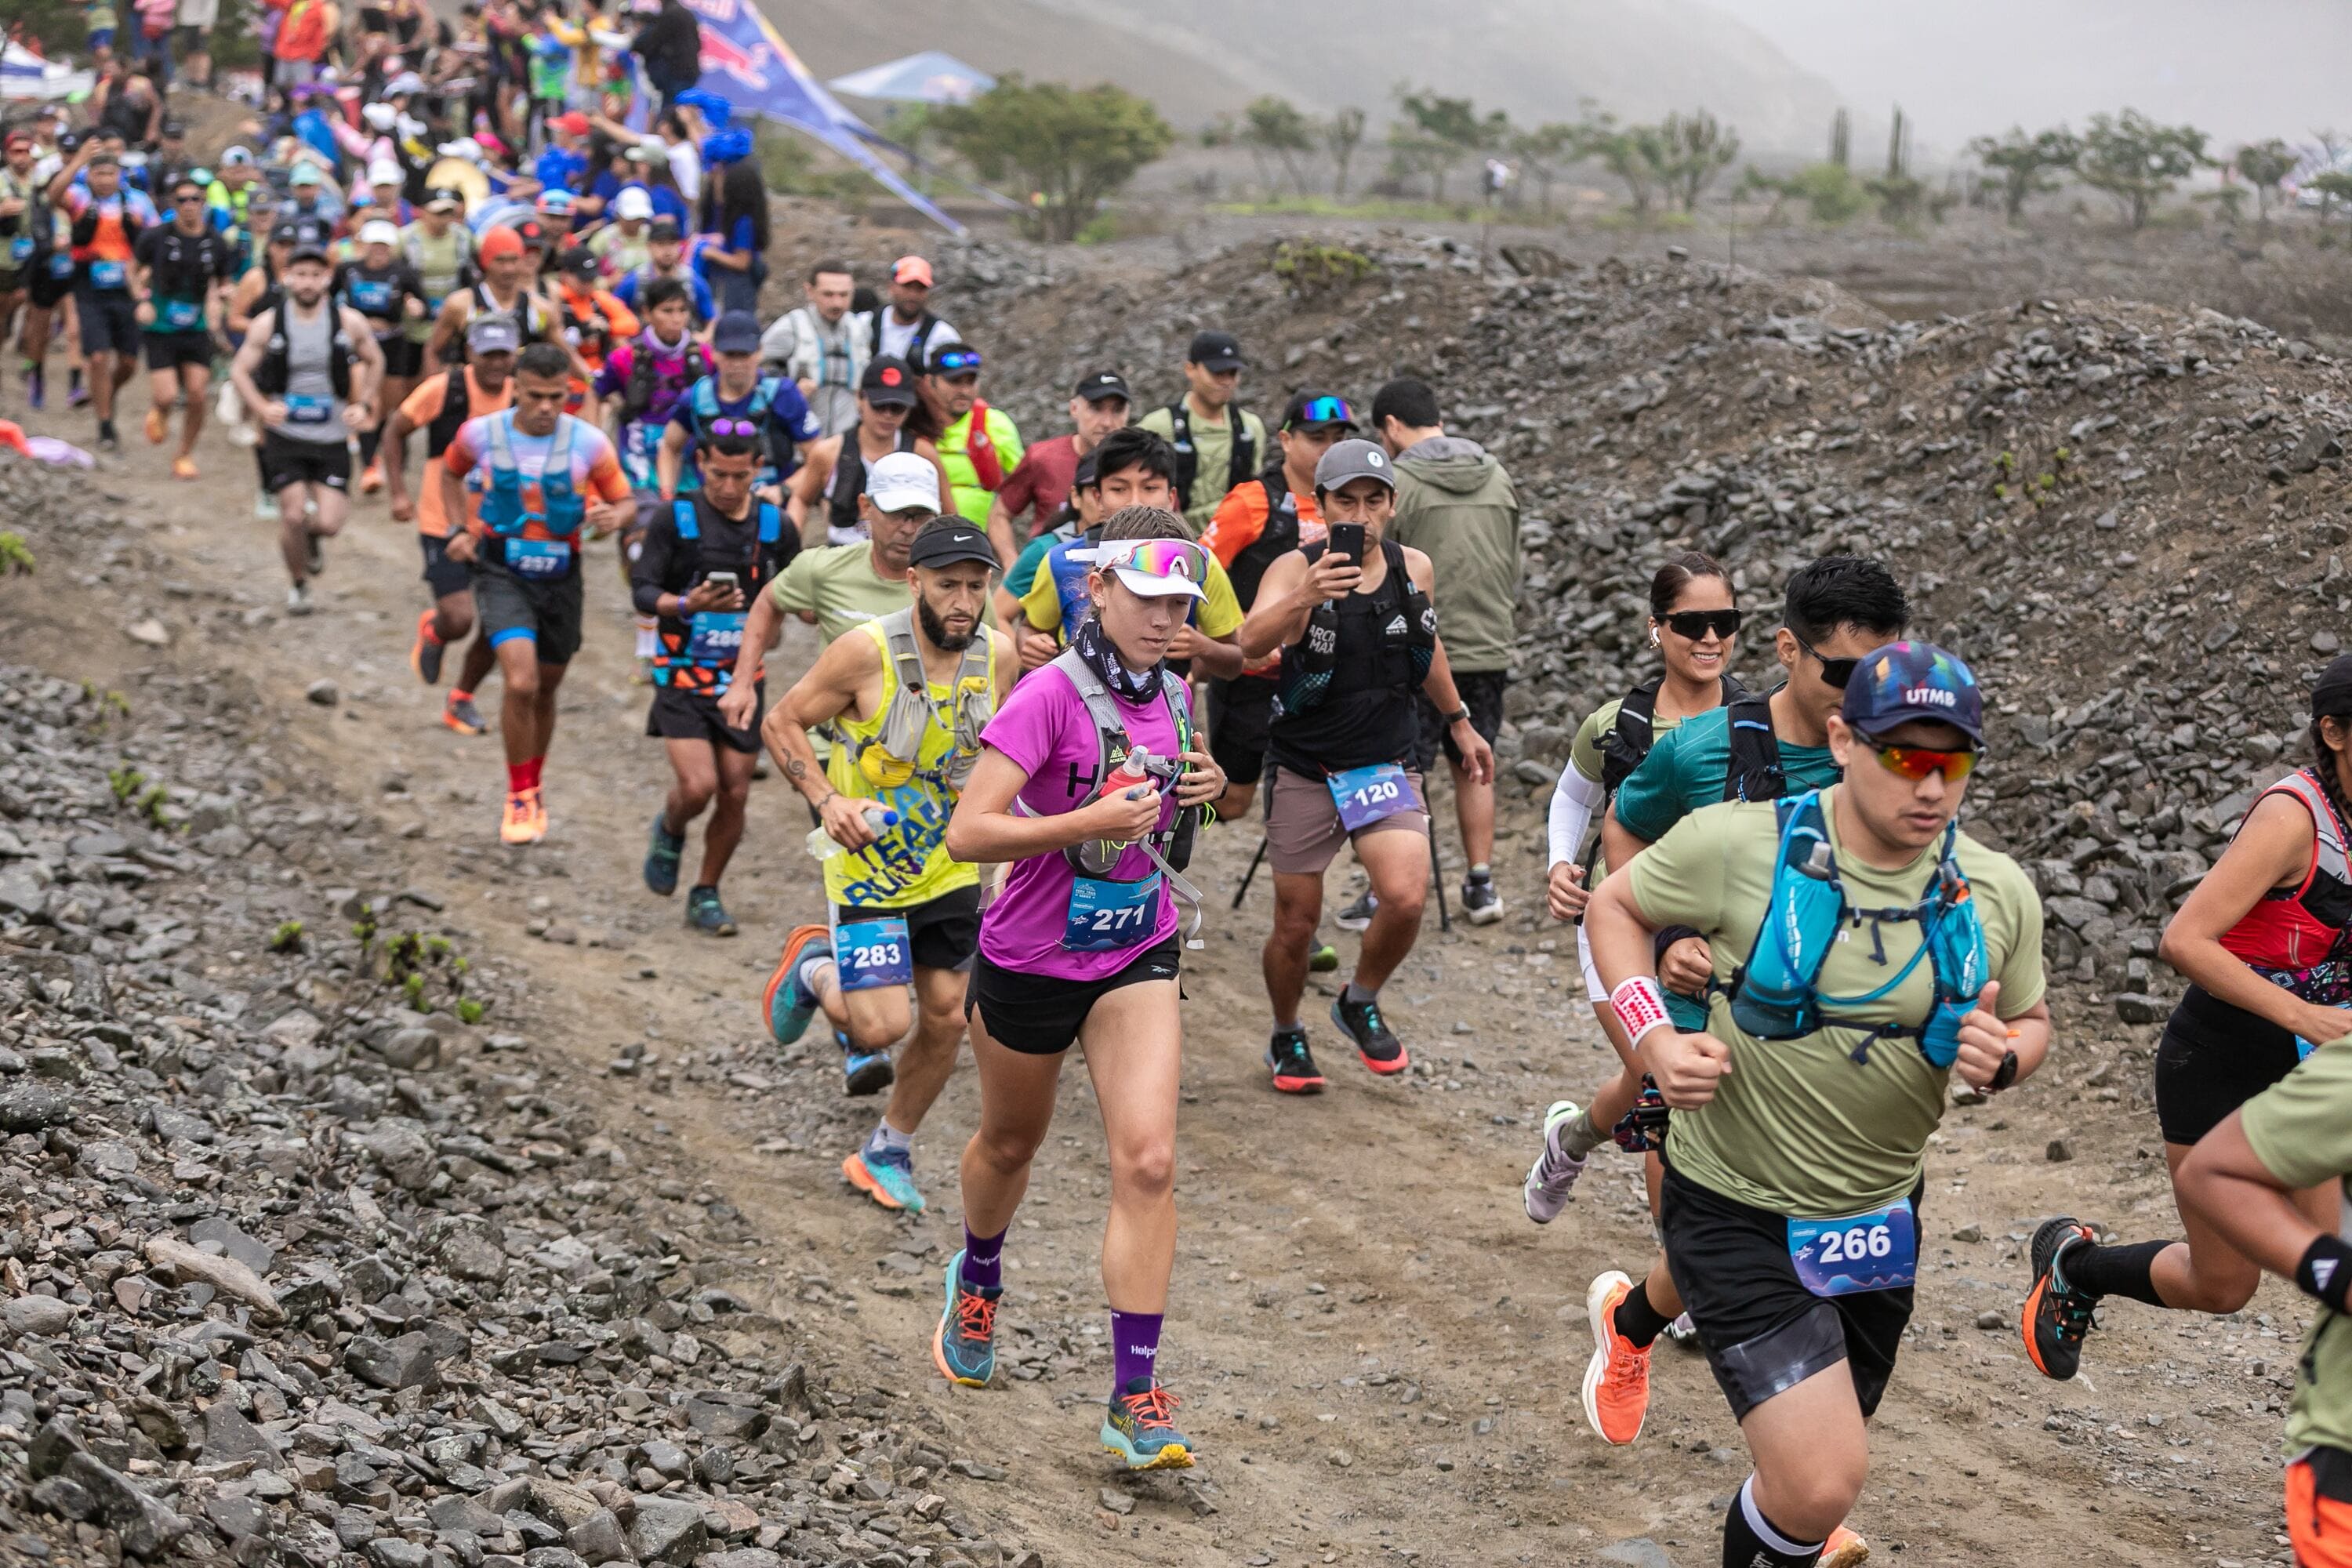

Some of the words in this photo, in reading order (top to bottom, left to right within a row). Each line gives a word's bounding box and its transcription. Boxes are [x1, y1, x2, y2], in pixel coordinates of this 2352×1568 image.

[1308, 638, 1334, 653] MAX
[1906, 688, 1957, 707] UTMB
[1355, 781, 1399, 806] 120
[1091, 903, 1145, 931] 271
[853, 943, 901, 969] 283
[1819, 1225, 1892, 1264] 266
